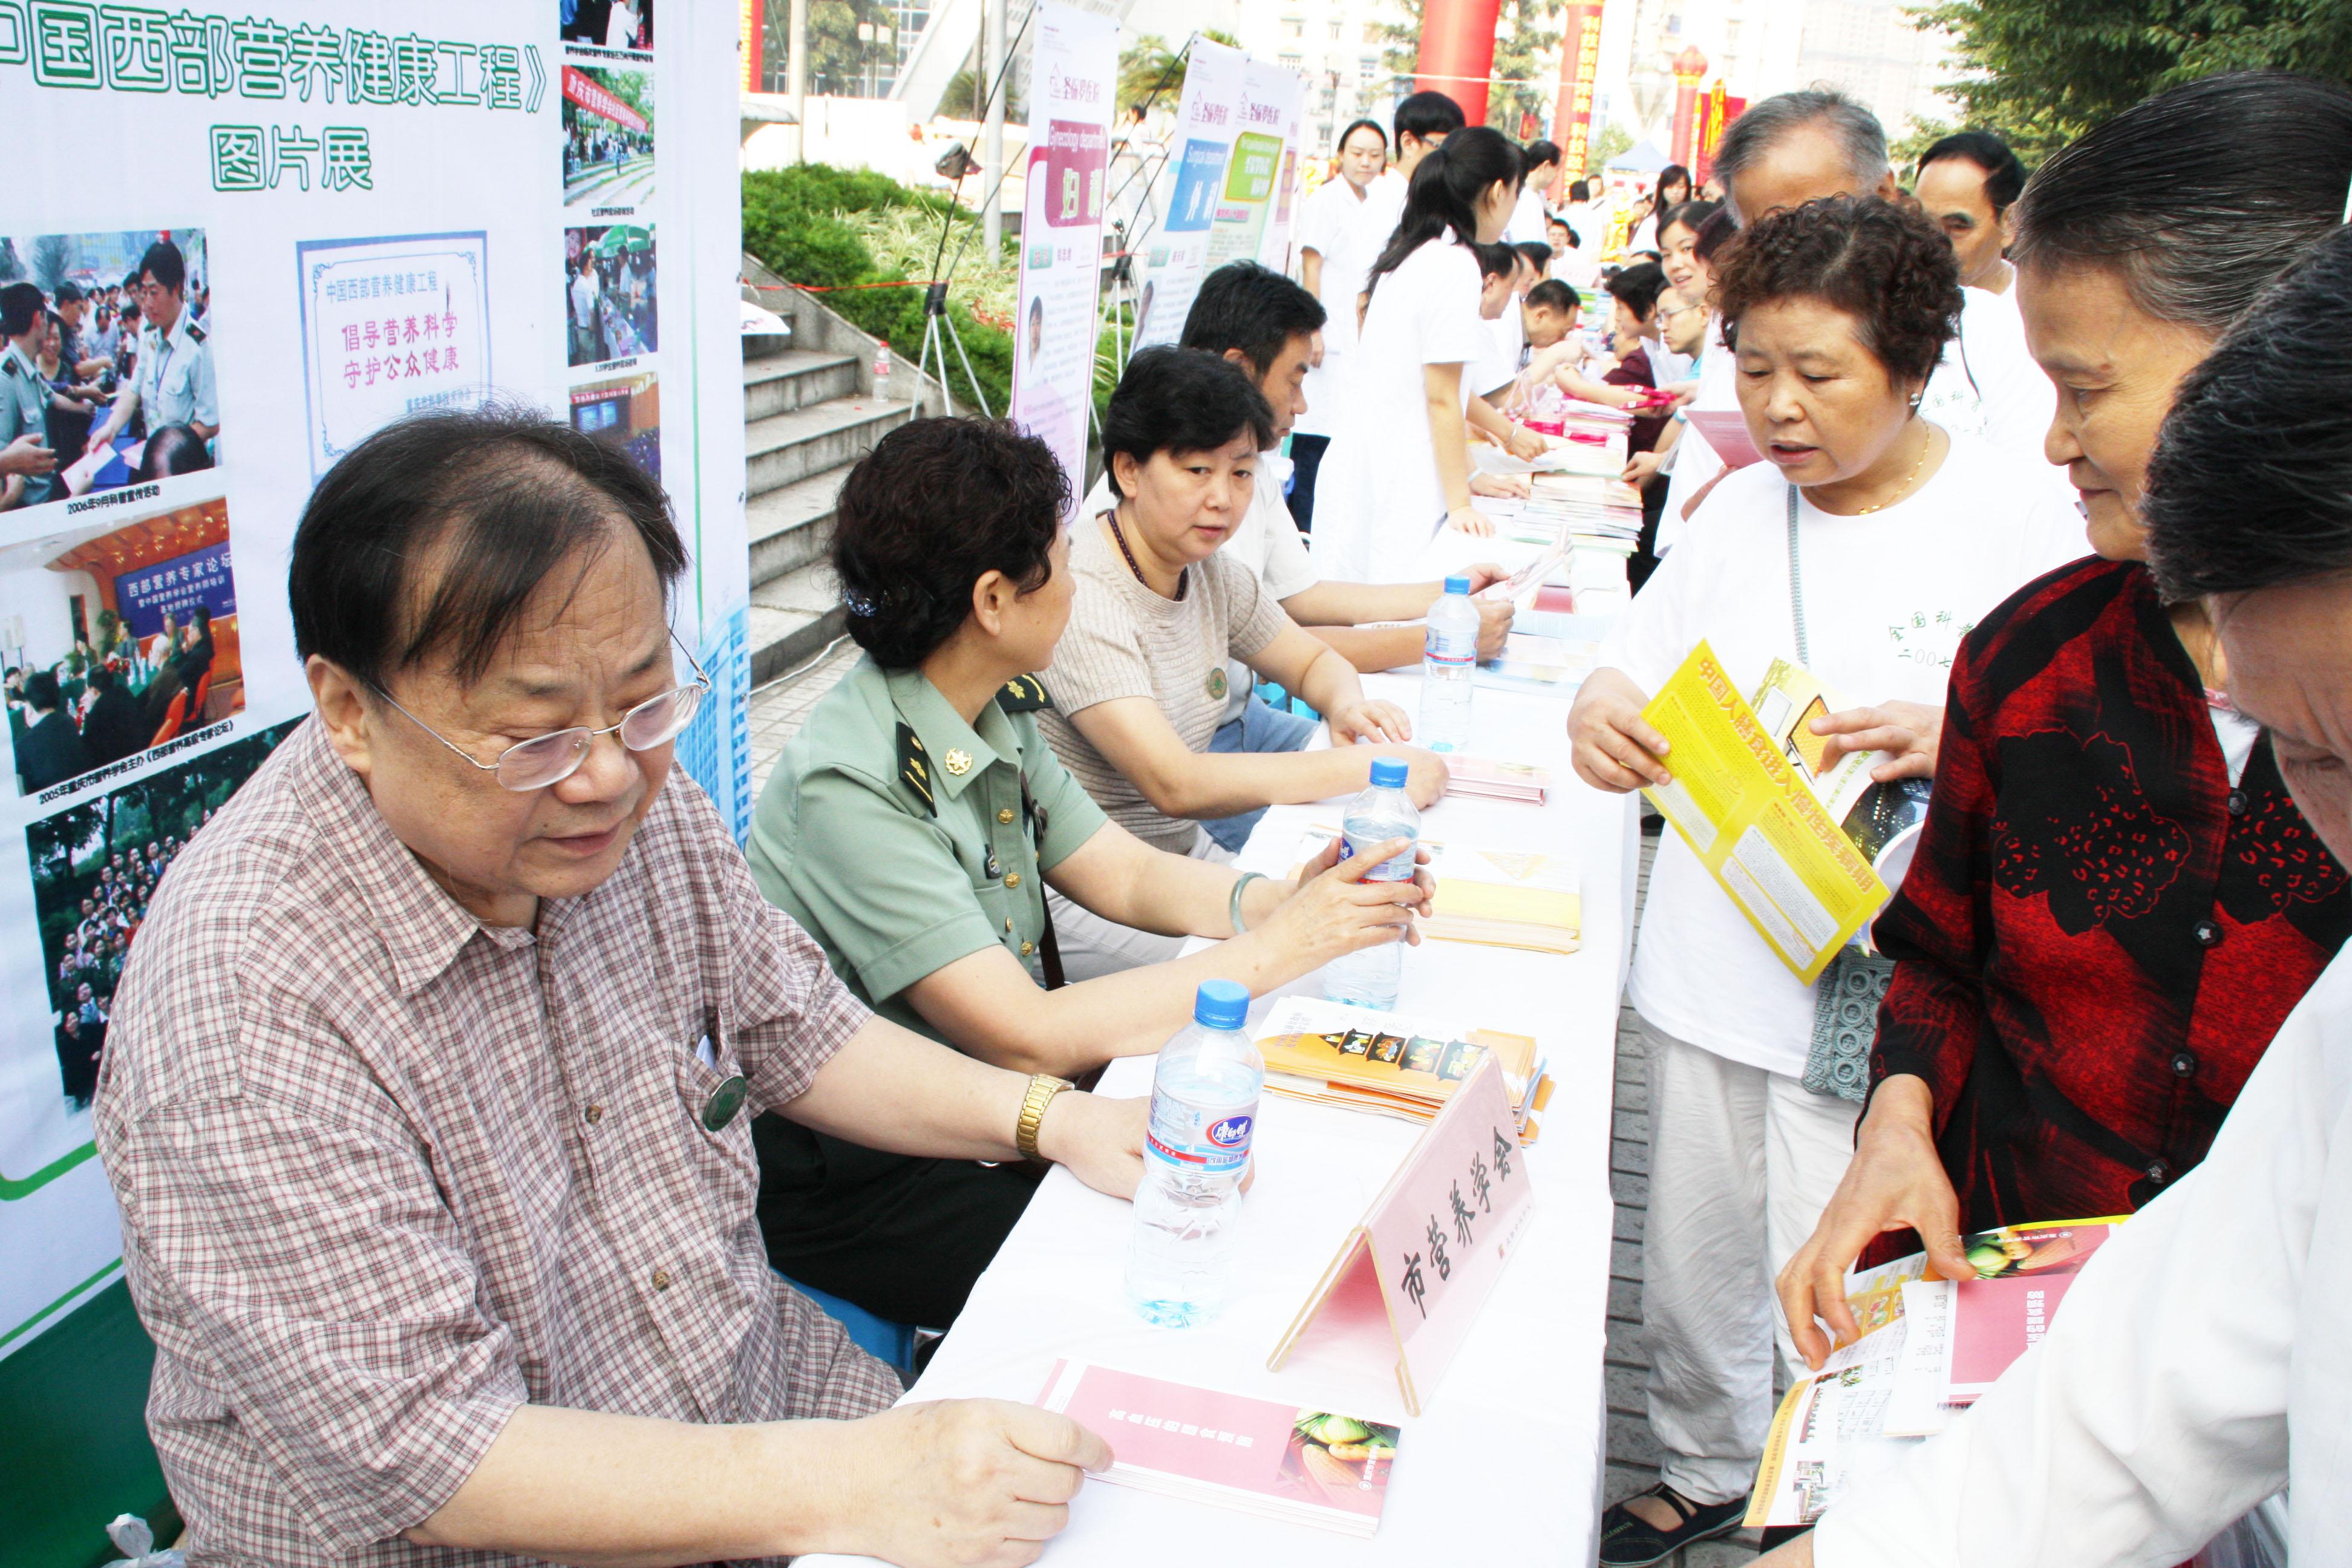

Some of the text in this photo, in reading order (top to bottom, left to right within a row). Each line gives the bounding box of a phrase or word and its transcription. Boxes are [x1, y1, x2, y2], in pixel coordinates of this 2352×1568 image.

[210, 124, 374, 192] 图片展
[1050, 125, 1079, 152] Gynecology
[326, 270, 439, 304] 中国西部营养健康工程
[342, 312, 458, 352] 倡导营养科学
[344, 345, 459, 390] 守护公众健康
[128, 553, 231, 598] 西部营养专家论坛
[1401, 1125, 1512, 1321] 市营养学会
